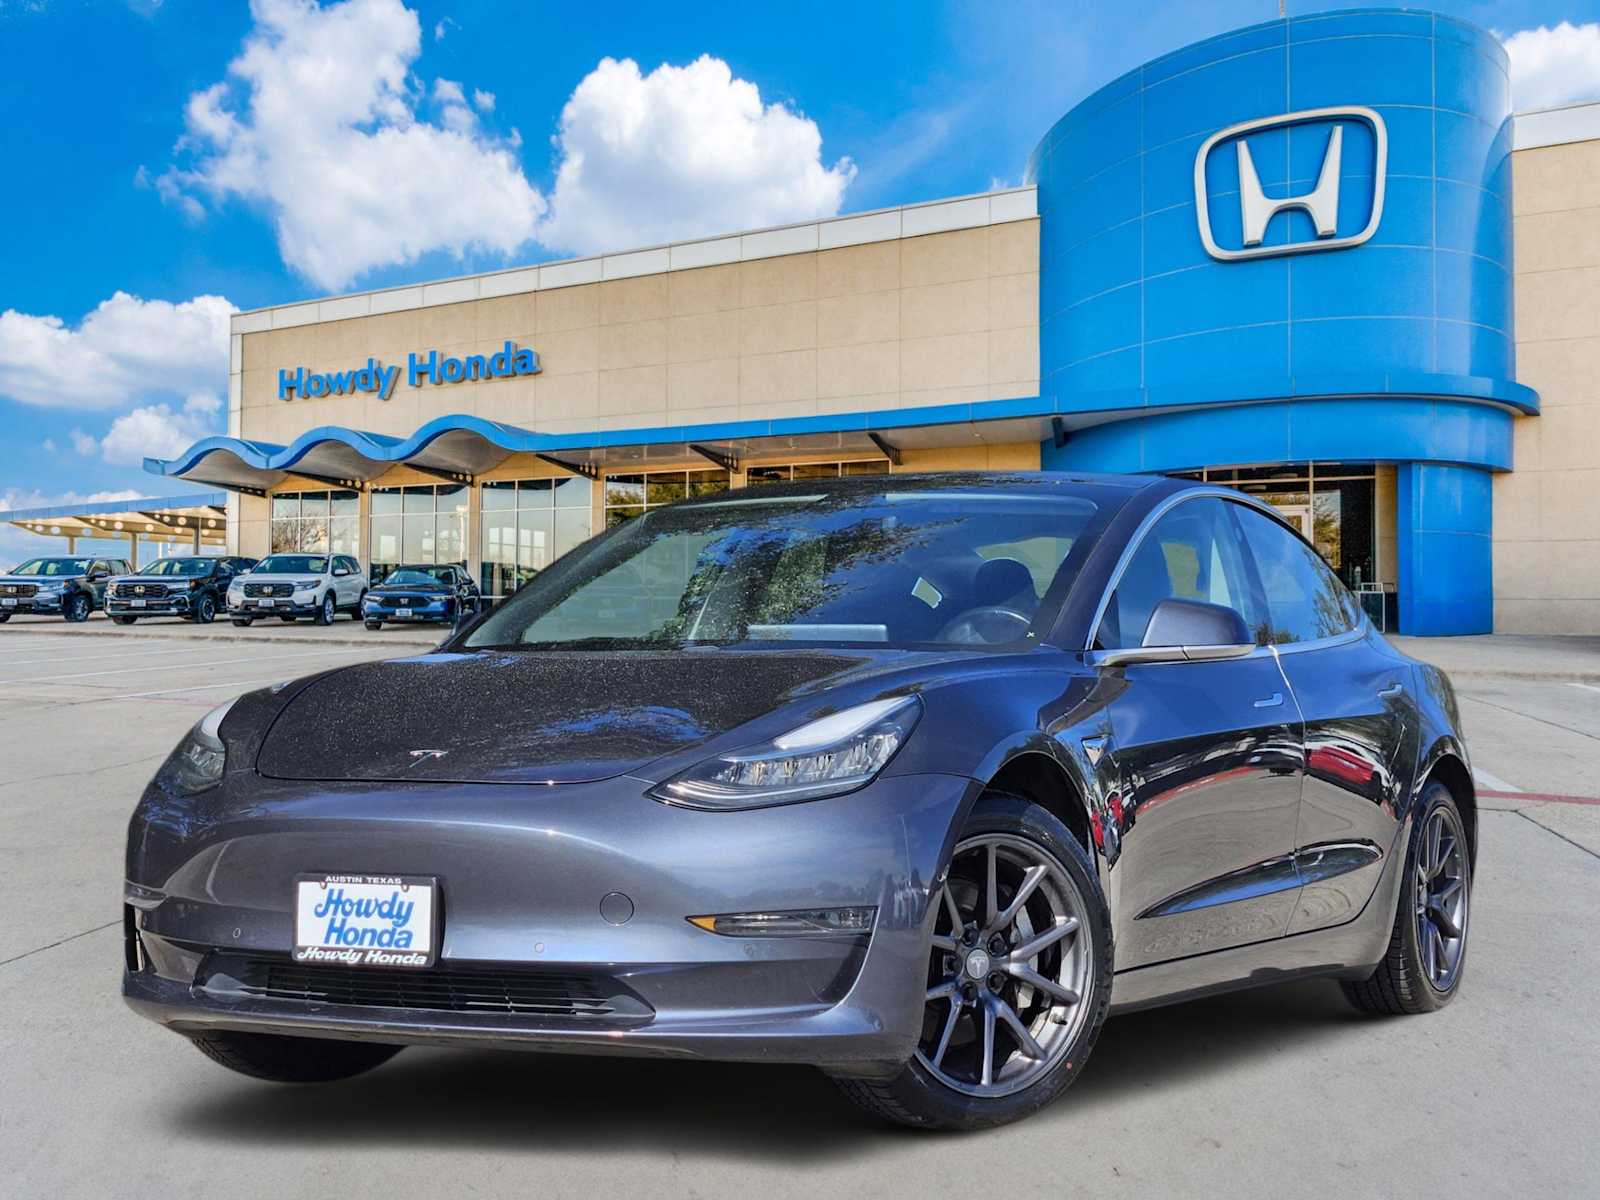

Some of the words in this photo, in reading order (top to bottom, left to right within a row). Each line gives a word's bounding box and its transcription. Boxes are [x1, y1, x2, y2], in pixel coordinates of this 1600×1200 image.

[278, 358, 402, 400] Howdy
[408, 340, 542, 387] Honda
[314, 888, 415, 927] Howdy
[323, 917, 414, 949] Honda
[297, 947, 363, 964] Howdy
[365, 949, 428, 965] Honda
